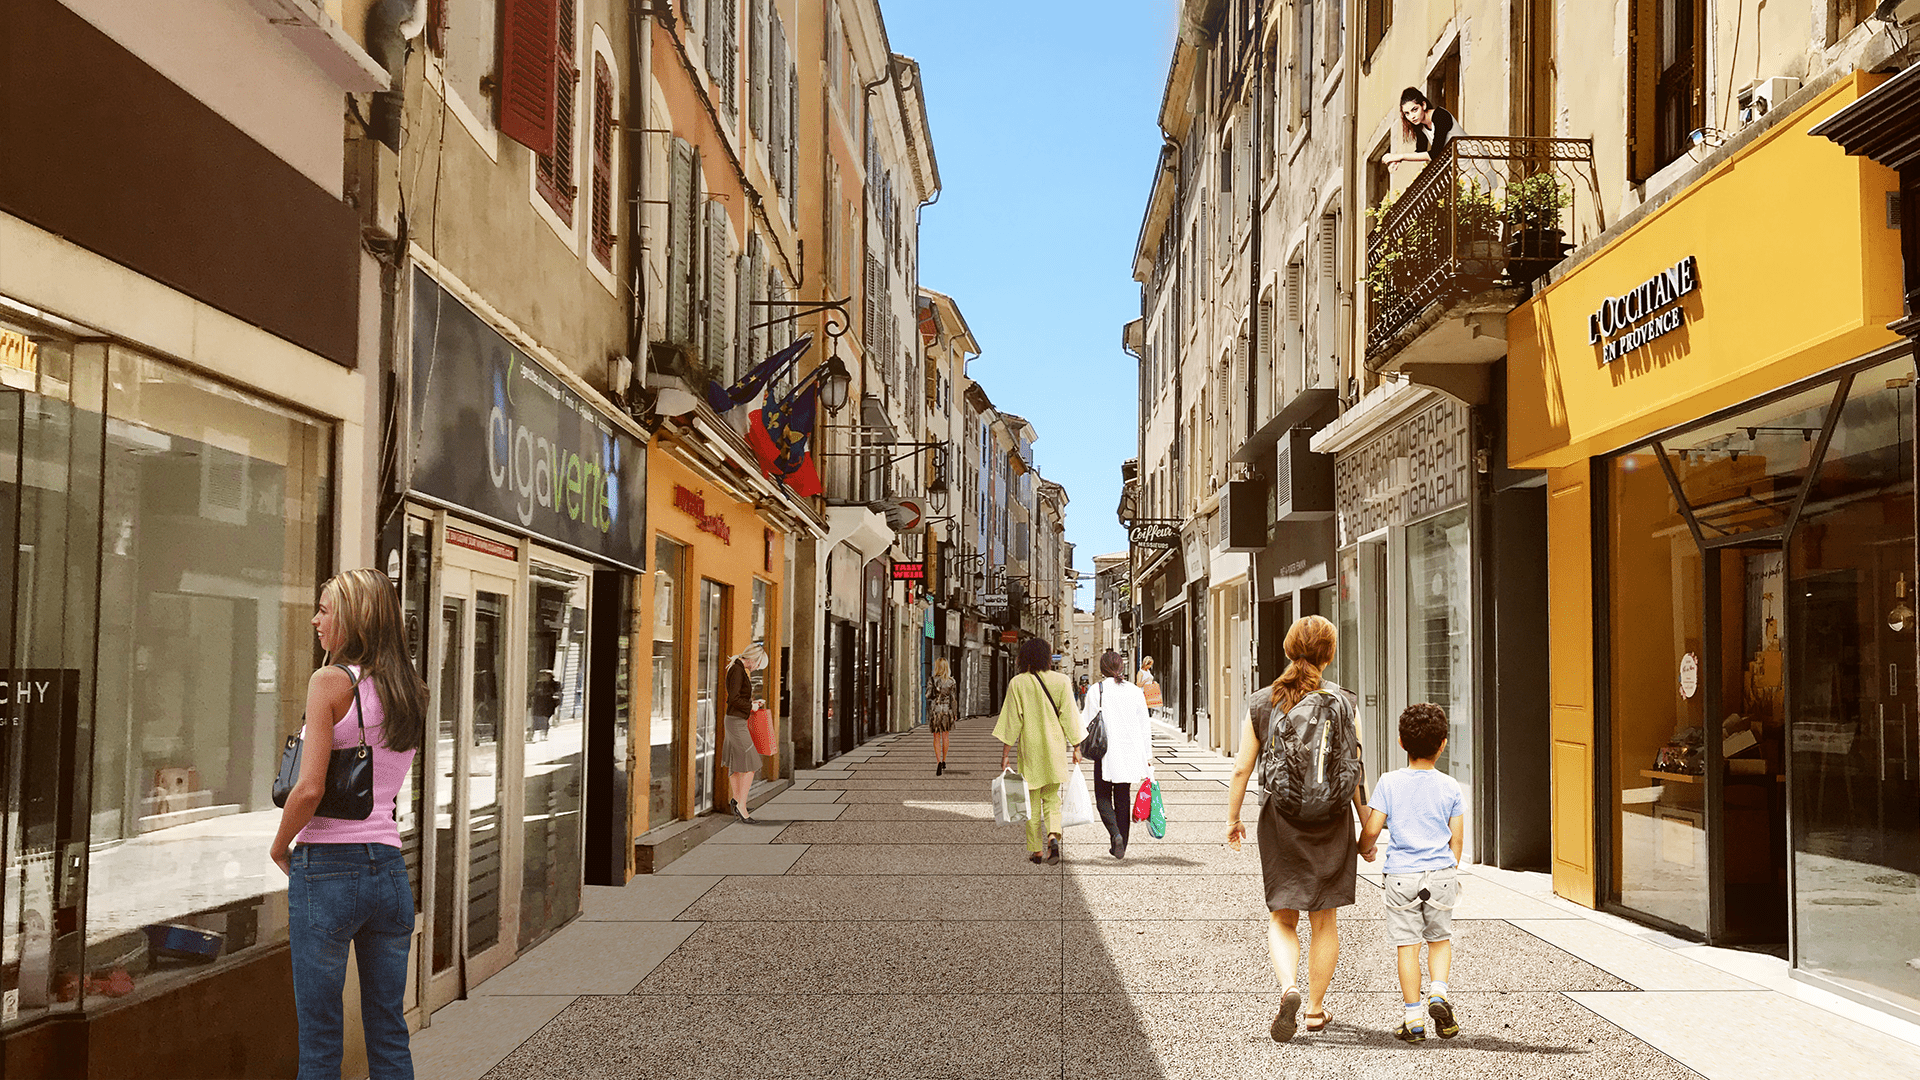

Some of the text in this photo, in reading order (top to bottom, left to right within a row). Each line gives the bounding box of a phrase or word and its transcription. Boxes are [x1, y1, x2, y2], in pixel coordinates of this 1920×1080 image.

[1588, 256, 1696, 346] L'OCCITANE
[1602, 306, 1682, 364] EN PROVENCE
[1130, 525, 1173, 542] Coiffeur
